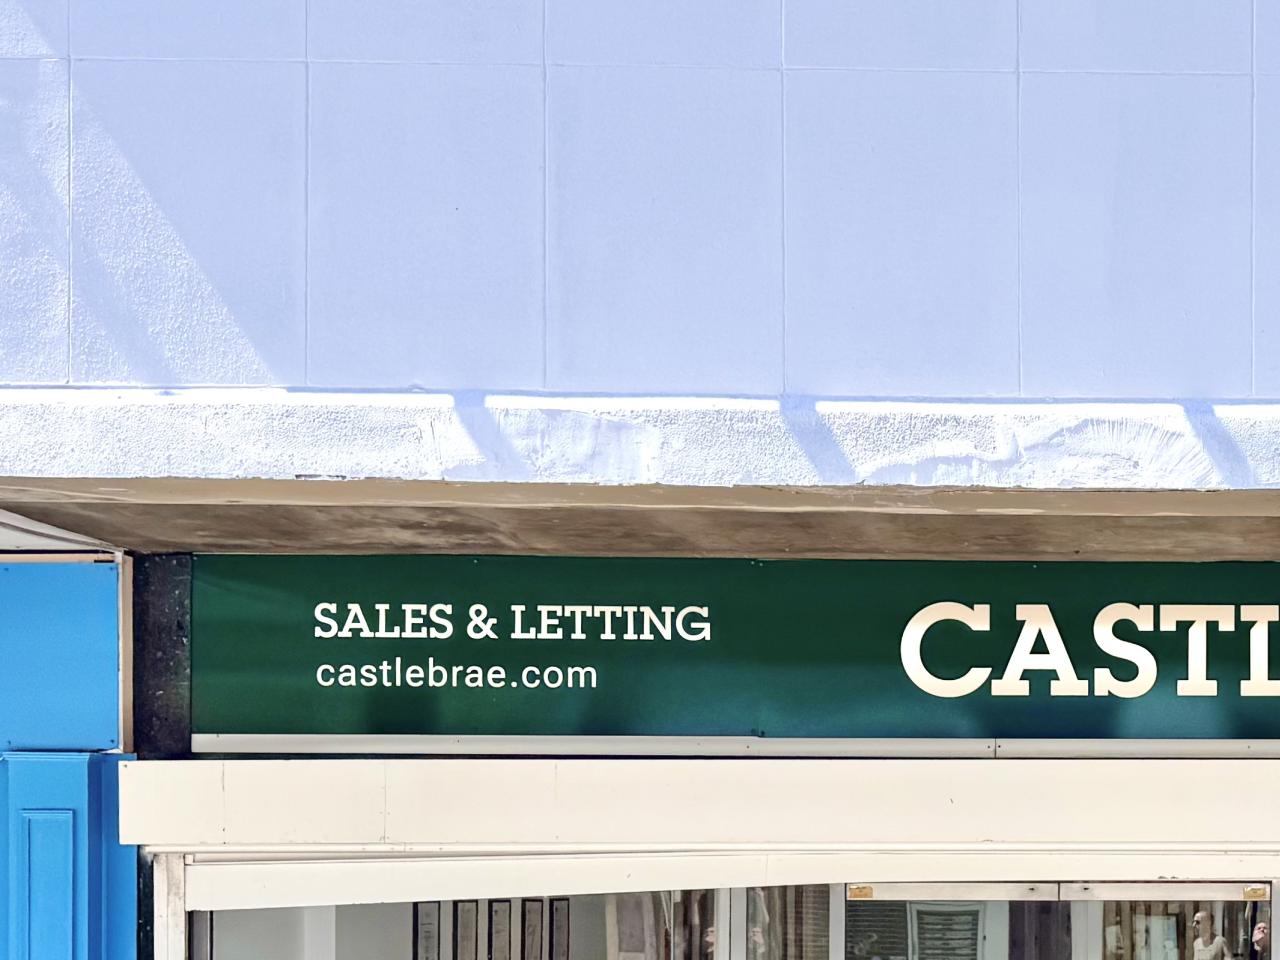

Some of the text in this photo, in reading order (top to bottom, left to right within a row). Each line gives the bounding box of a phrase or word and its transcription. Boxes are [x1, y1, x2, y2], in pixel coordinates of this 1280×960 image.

[314, 602, 711, 641] SALES & LETTING
[316, 656, 598, 689] castlebrae.com
